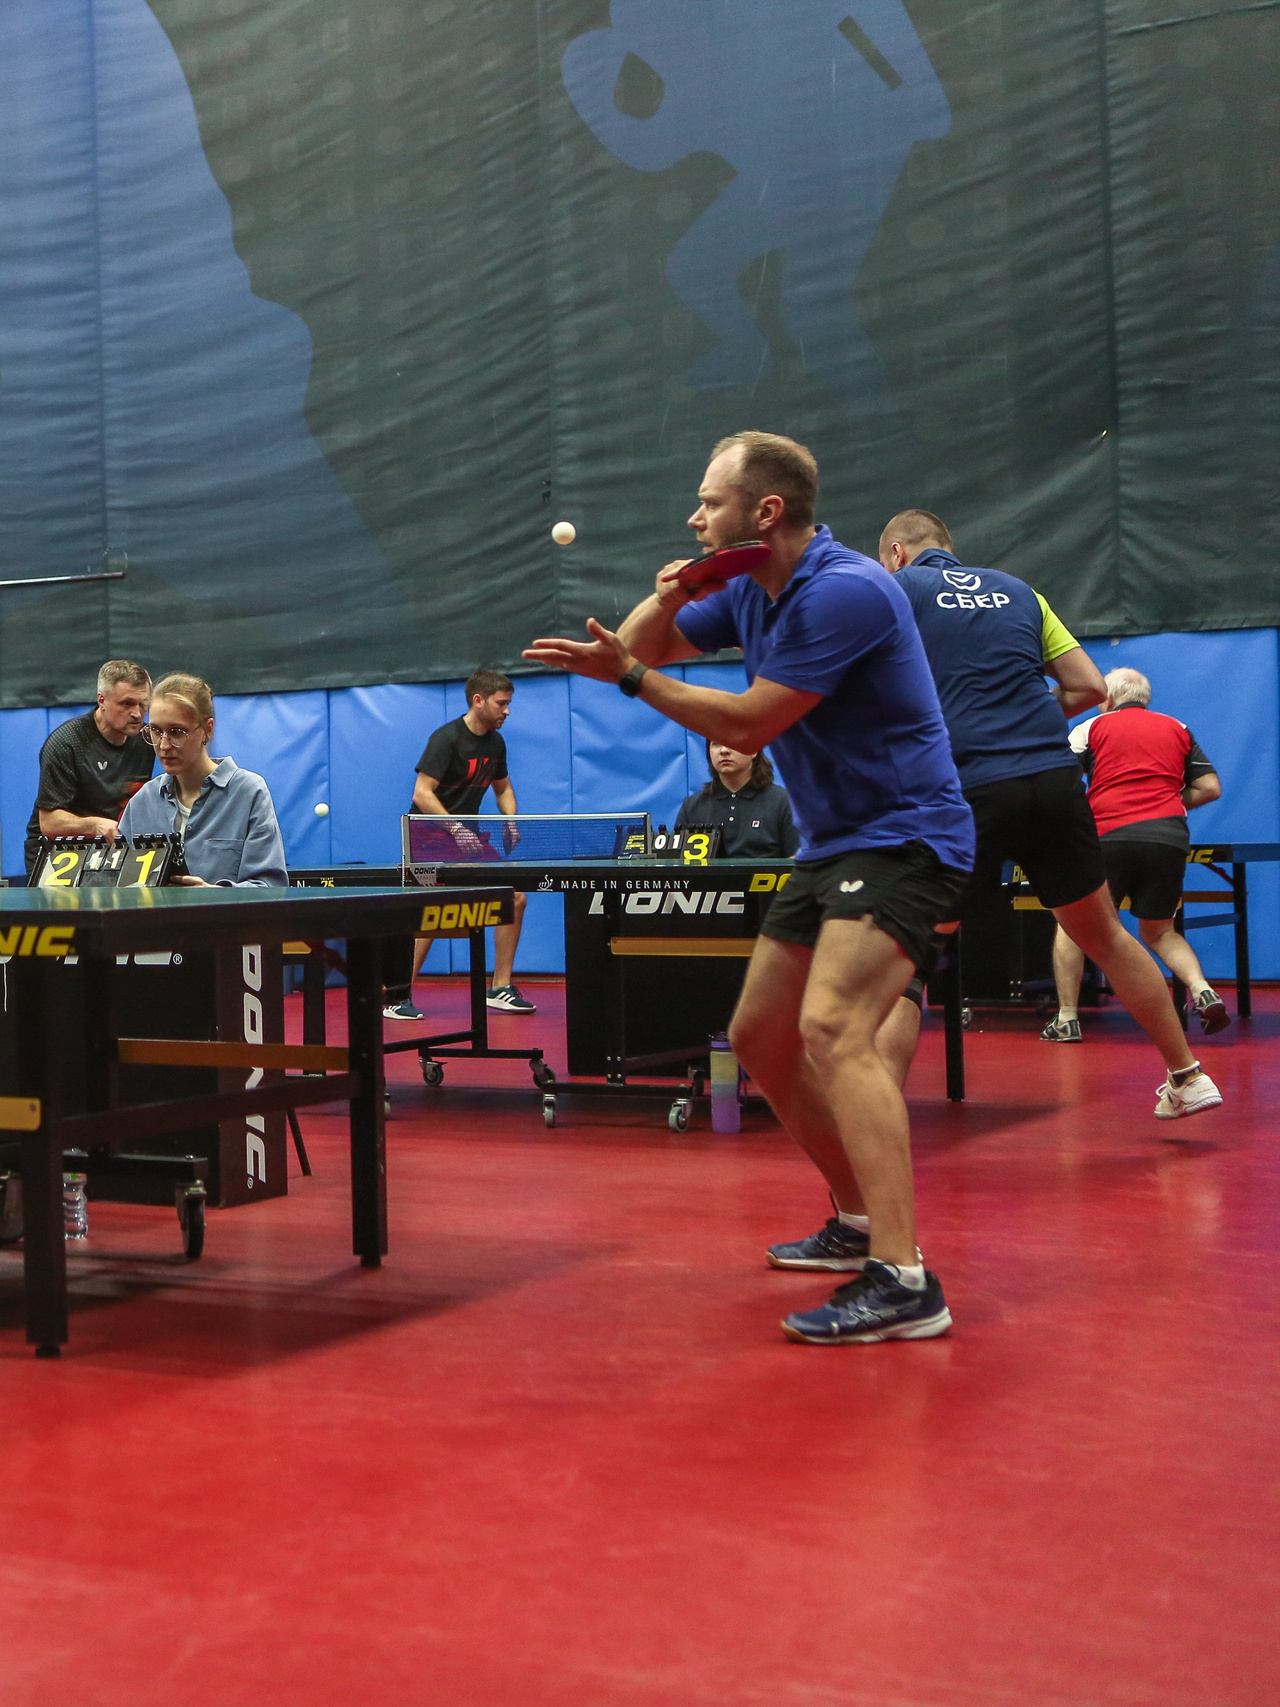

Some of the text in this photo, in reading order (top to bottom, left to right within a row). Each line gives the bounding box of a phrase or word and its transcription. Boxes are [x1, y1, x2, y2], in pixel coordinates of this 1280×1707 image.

[936, 592, 1011, 610] СБЕР
[654, 836, 666, 850] 0
[672, 835, 681, 850] 1
[683, 833, 710, 860] 3
[43, 852, 79, 886] 2
[110, 850, 122, 869] 1
[135, 851, 156, 885] 1
[414, 867, 436, 875] DONIC
[560, 880, 596, 889] MADE
[604, 880, 617, 889] IN
[625, 880, 690, 889] GERMANY
[421, 901, 502, 931] DONIC
